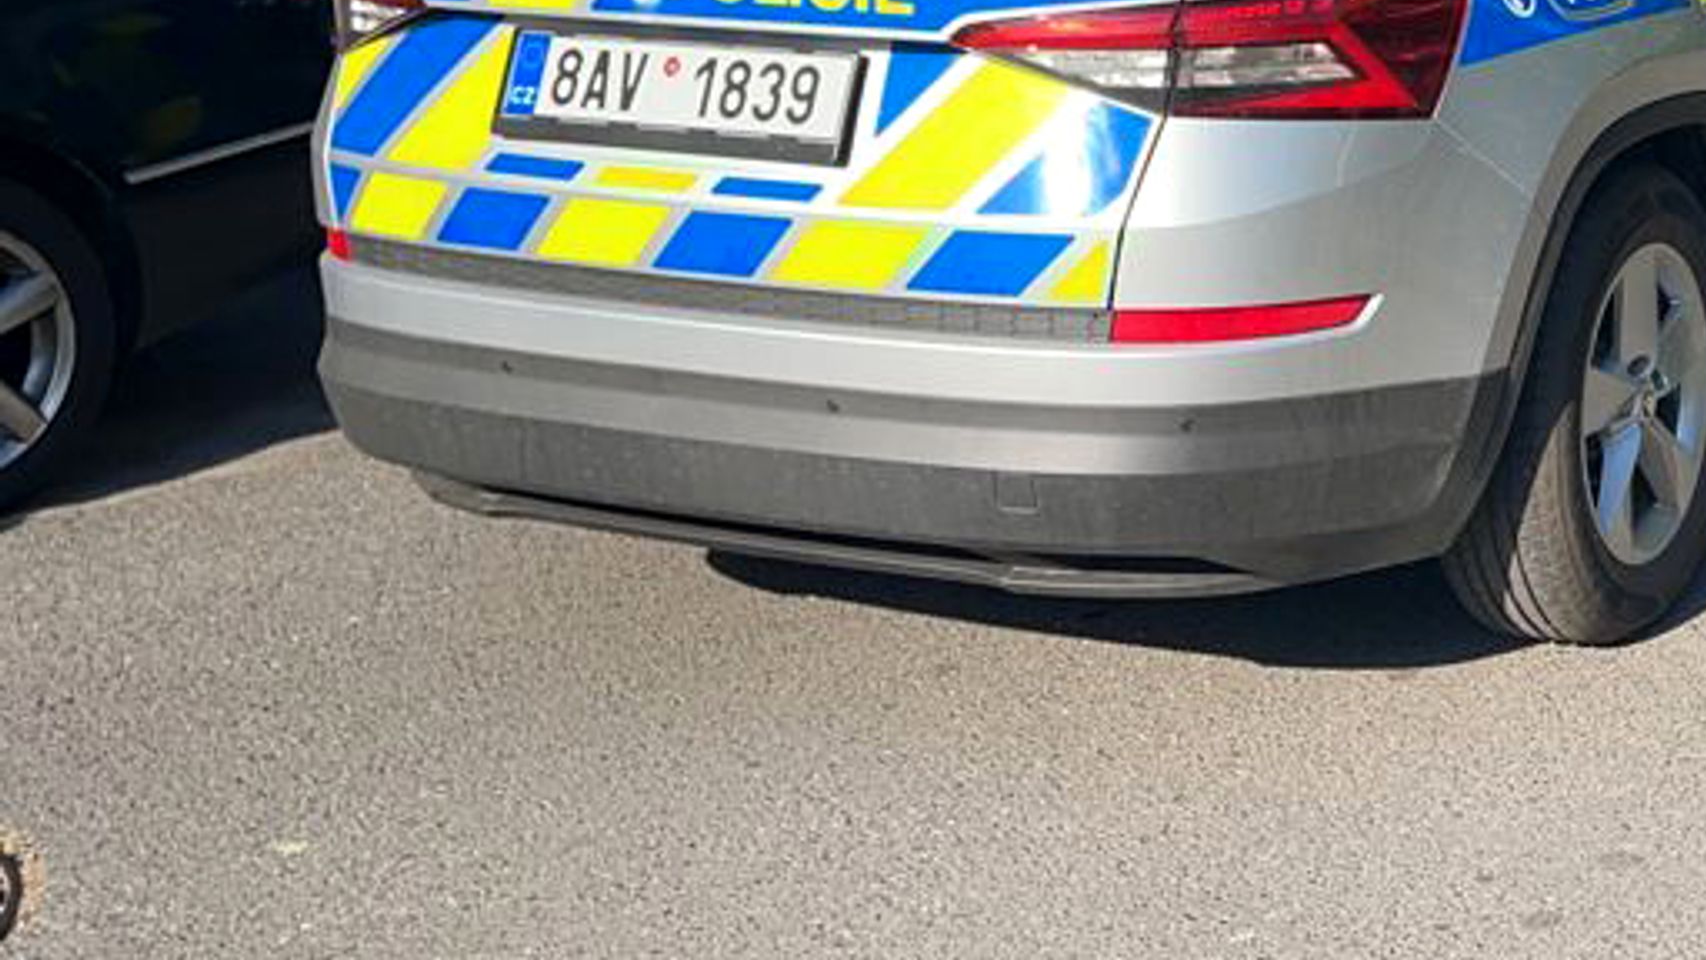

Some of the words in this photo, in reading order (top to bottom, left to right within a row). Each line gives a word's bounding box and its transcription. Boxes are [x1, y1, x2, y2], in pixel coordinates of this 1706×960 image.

[509, 85, 537, 106] CZ
[552, 48, 649, 112] 8AV
[694, 56, 821, 125] 1839
